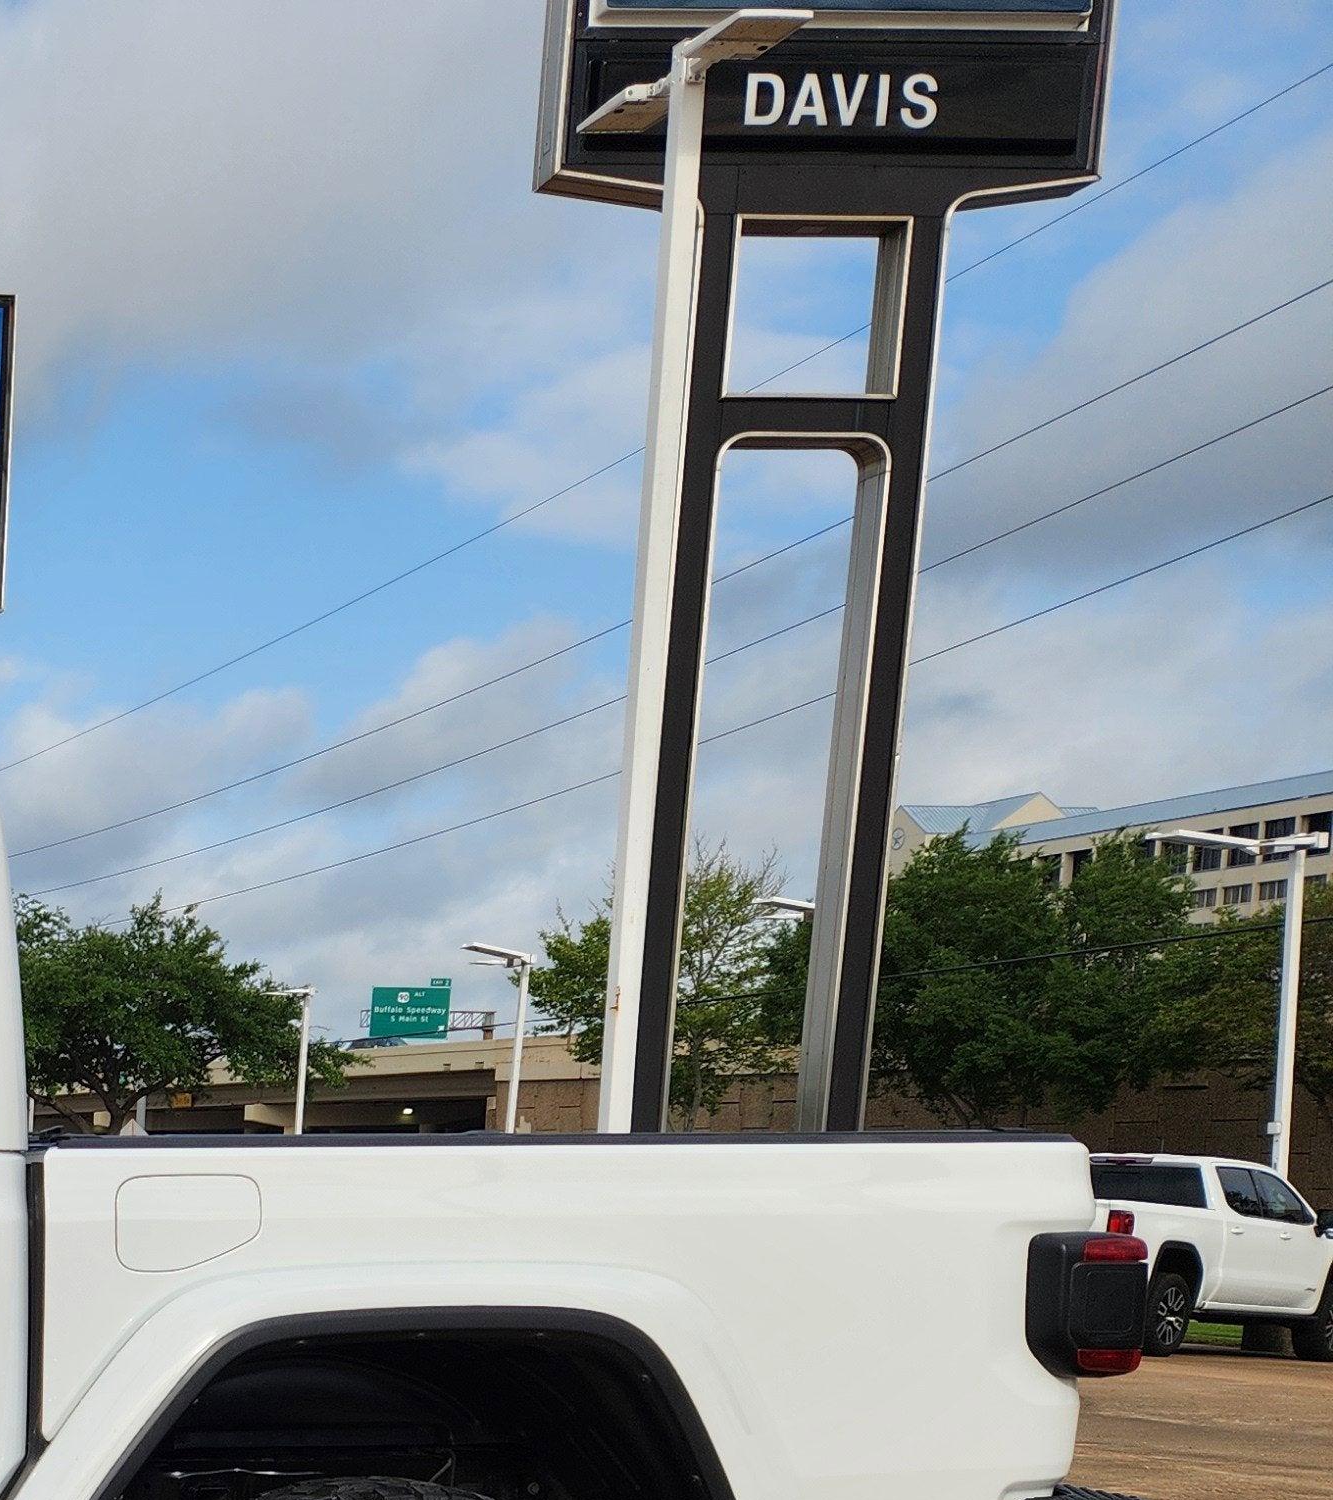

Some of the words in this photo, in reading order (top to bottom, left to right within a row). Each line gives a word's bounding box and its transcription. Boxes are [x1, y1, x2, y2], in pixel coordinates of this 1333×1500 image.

[744, 73, 939, 130] DAVIS
[374, 1006, 403, 1014] Buffalo
[406, 1006, 446, 1016] Speedway
[398, 1015, 417, 1023] Main
[420, 1015, 429, 1023] St
